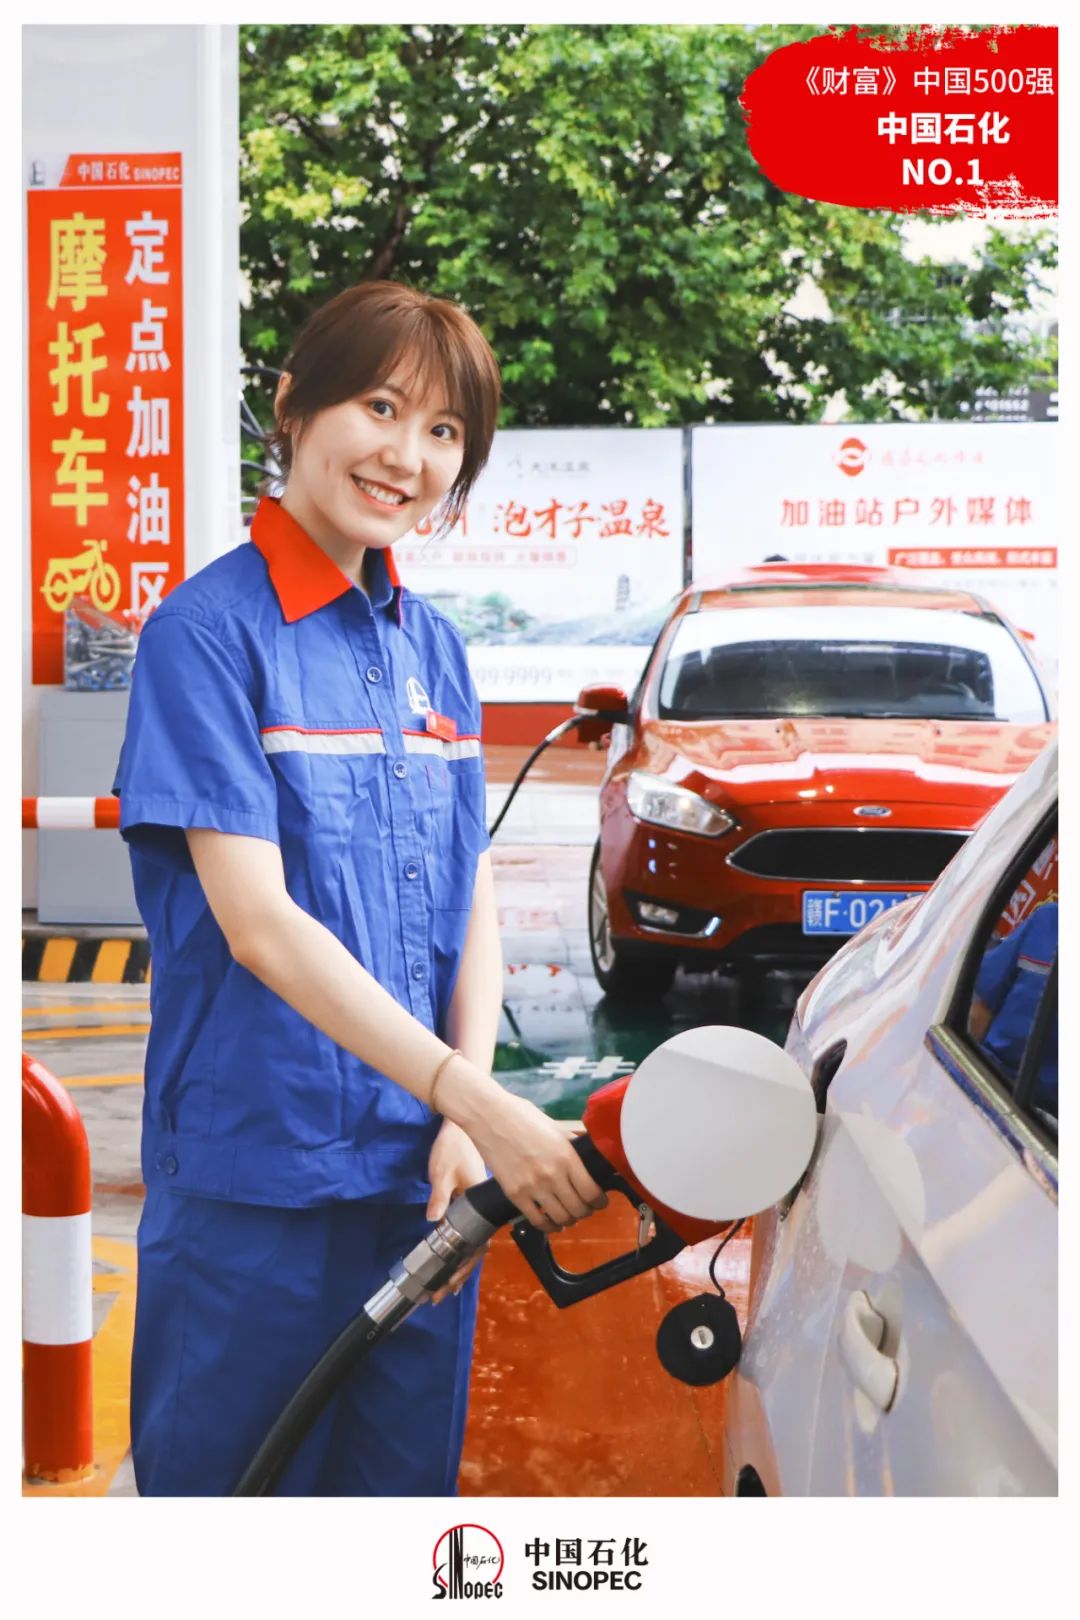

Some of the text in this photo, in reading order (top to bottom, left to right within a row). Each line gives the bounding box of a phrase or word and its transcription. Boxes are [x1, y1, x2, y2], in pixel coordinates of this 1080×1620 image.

[78, 160, 131, 182] 中国石化
[133, 166, 181, 181] SINOPEC
[46, 211, 110, 527] 摩托车
[124, 210, 172, 617] 定点加油区
[780, 497, 1034, 526] 加油站户外媒体
[807, 898, 898, 927] 赣F·02
